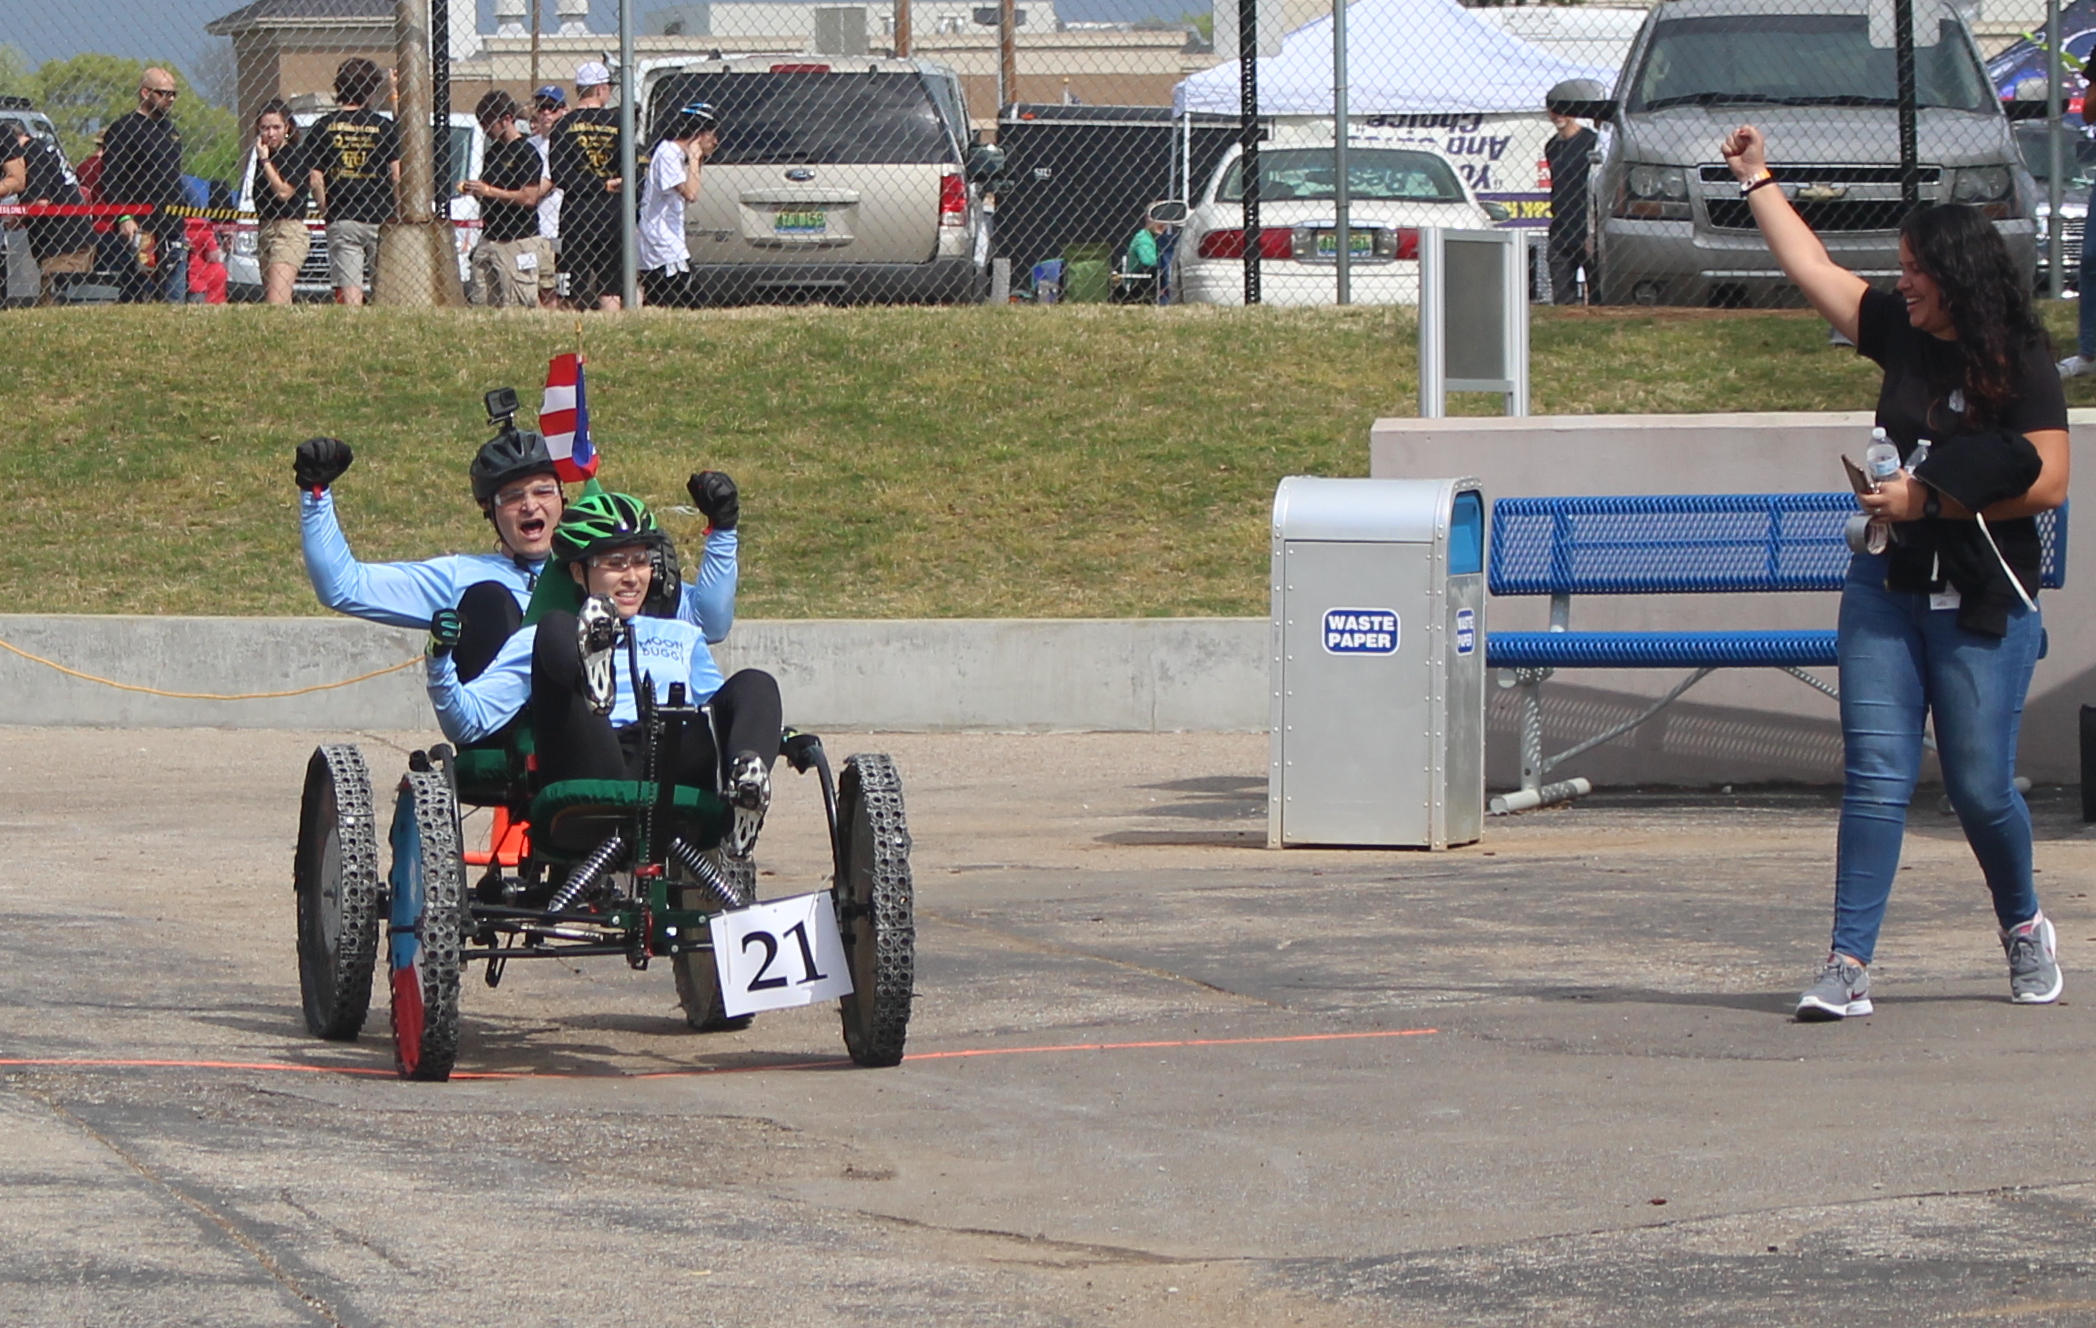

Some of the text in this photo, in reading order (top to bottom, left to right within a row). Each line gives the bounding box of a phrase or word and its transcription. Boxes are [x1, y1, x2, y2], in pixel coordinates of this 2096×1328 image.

[1328, 615, 1395, 631] WASTE
[1328, 632, 1391, 649] PAPER
[741, 920, 828, 993] 21
